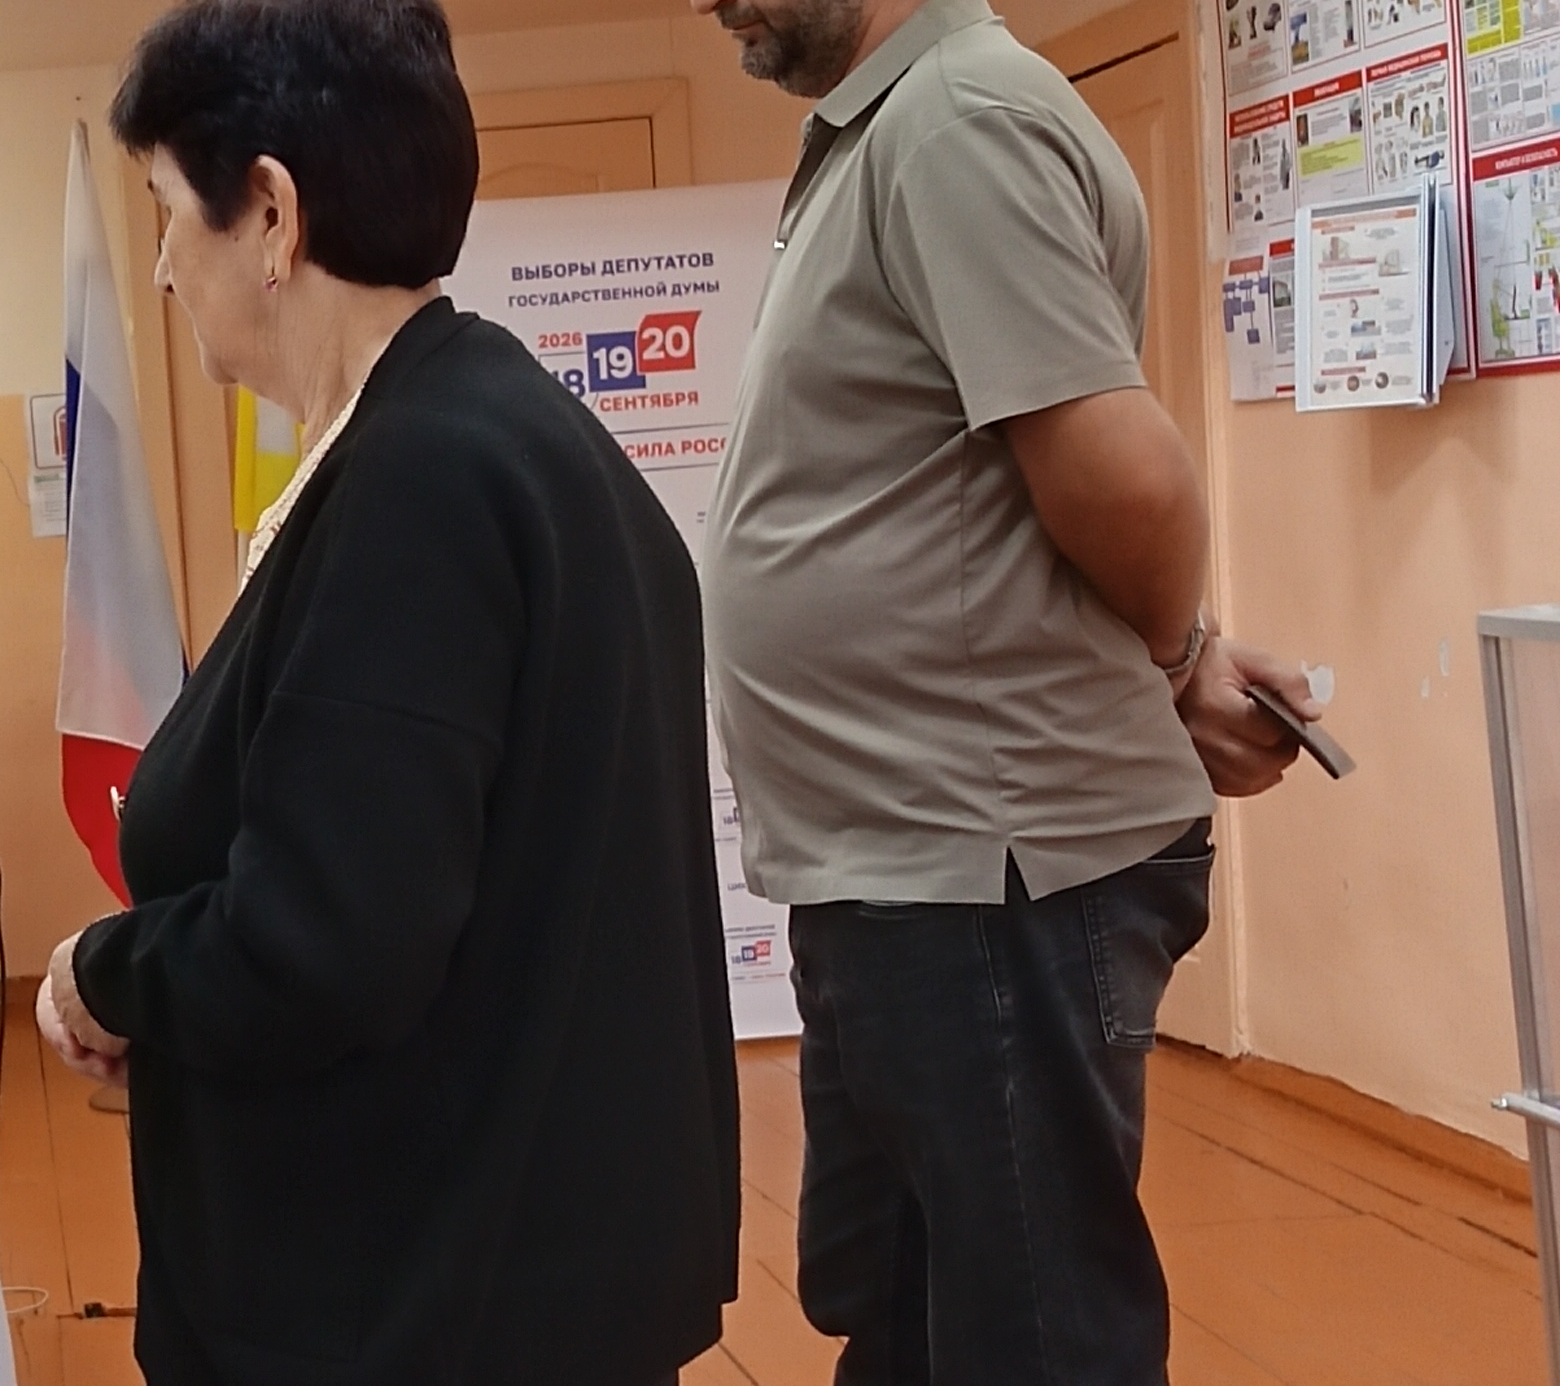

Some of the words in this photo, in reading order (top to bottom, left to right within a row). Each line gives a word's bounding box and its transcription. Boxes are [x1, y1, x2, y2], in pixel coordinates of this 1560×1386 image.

[511, 261, 596, 282] ВЫБОРЫ
[601, 252, 715, 277] ДЕПУТАТОВ
[508, 281, 668, 308] ГОСУДАРСТВЕННОЙ
[671, 280, 720, 299] ДУМЫ
[538, 332, 583, 348] 2026
[592, 346, 632, 380] 19
[642, 325, 689, 360] 20
[600, 391, 699, 412] СЕНТЯБРЯ
